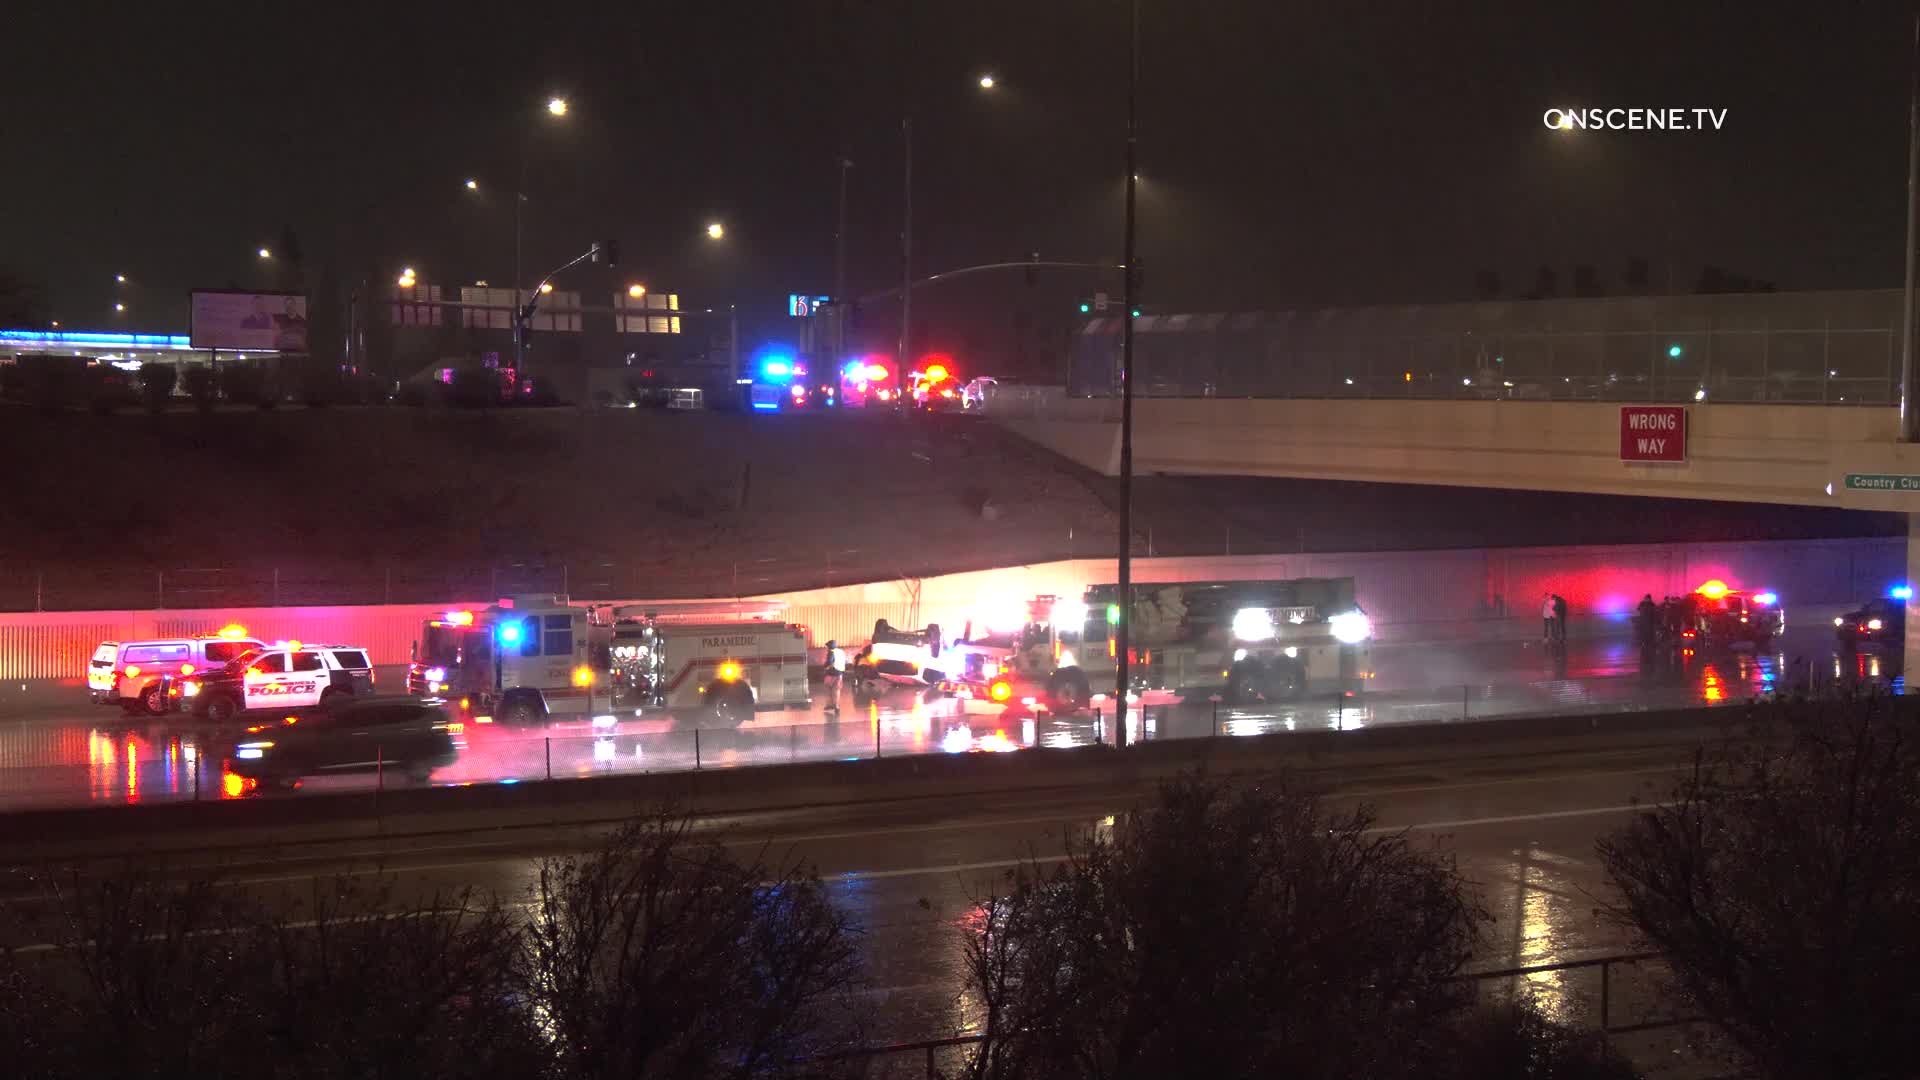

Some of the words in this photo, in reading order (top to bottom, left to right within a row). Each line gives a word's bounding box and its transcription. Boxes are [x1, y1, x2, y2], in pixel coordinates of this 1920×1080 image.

[1629, 413, 1676, 430] WRONG
[1637, 438, 1666, 454] WAY
[1854, 476, 1895, 489] Country
[1901, 477, 1920, 488] Clu
[247, 685, 316, 697] POLICE
